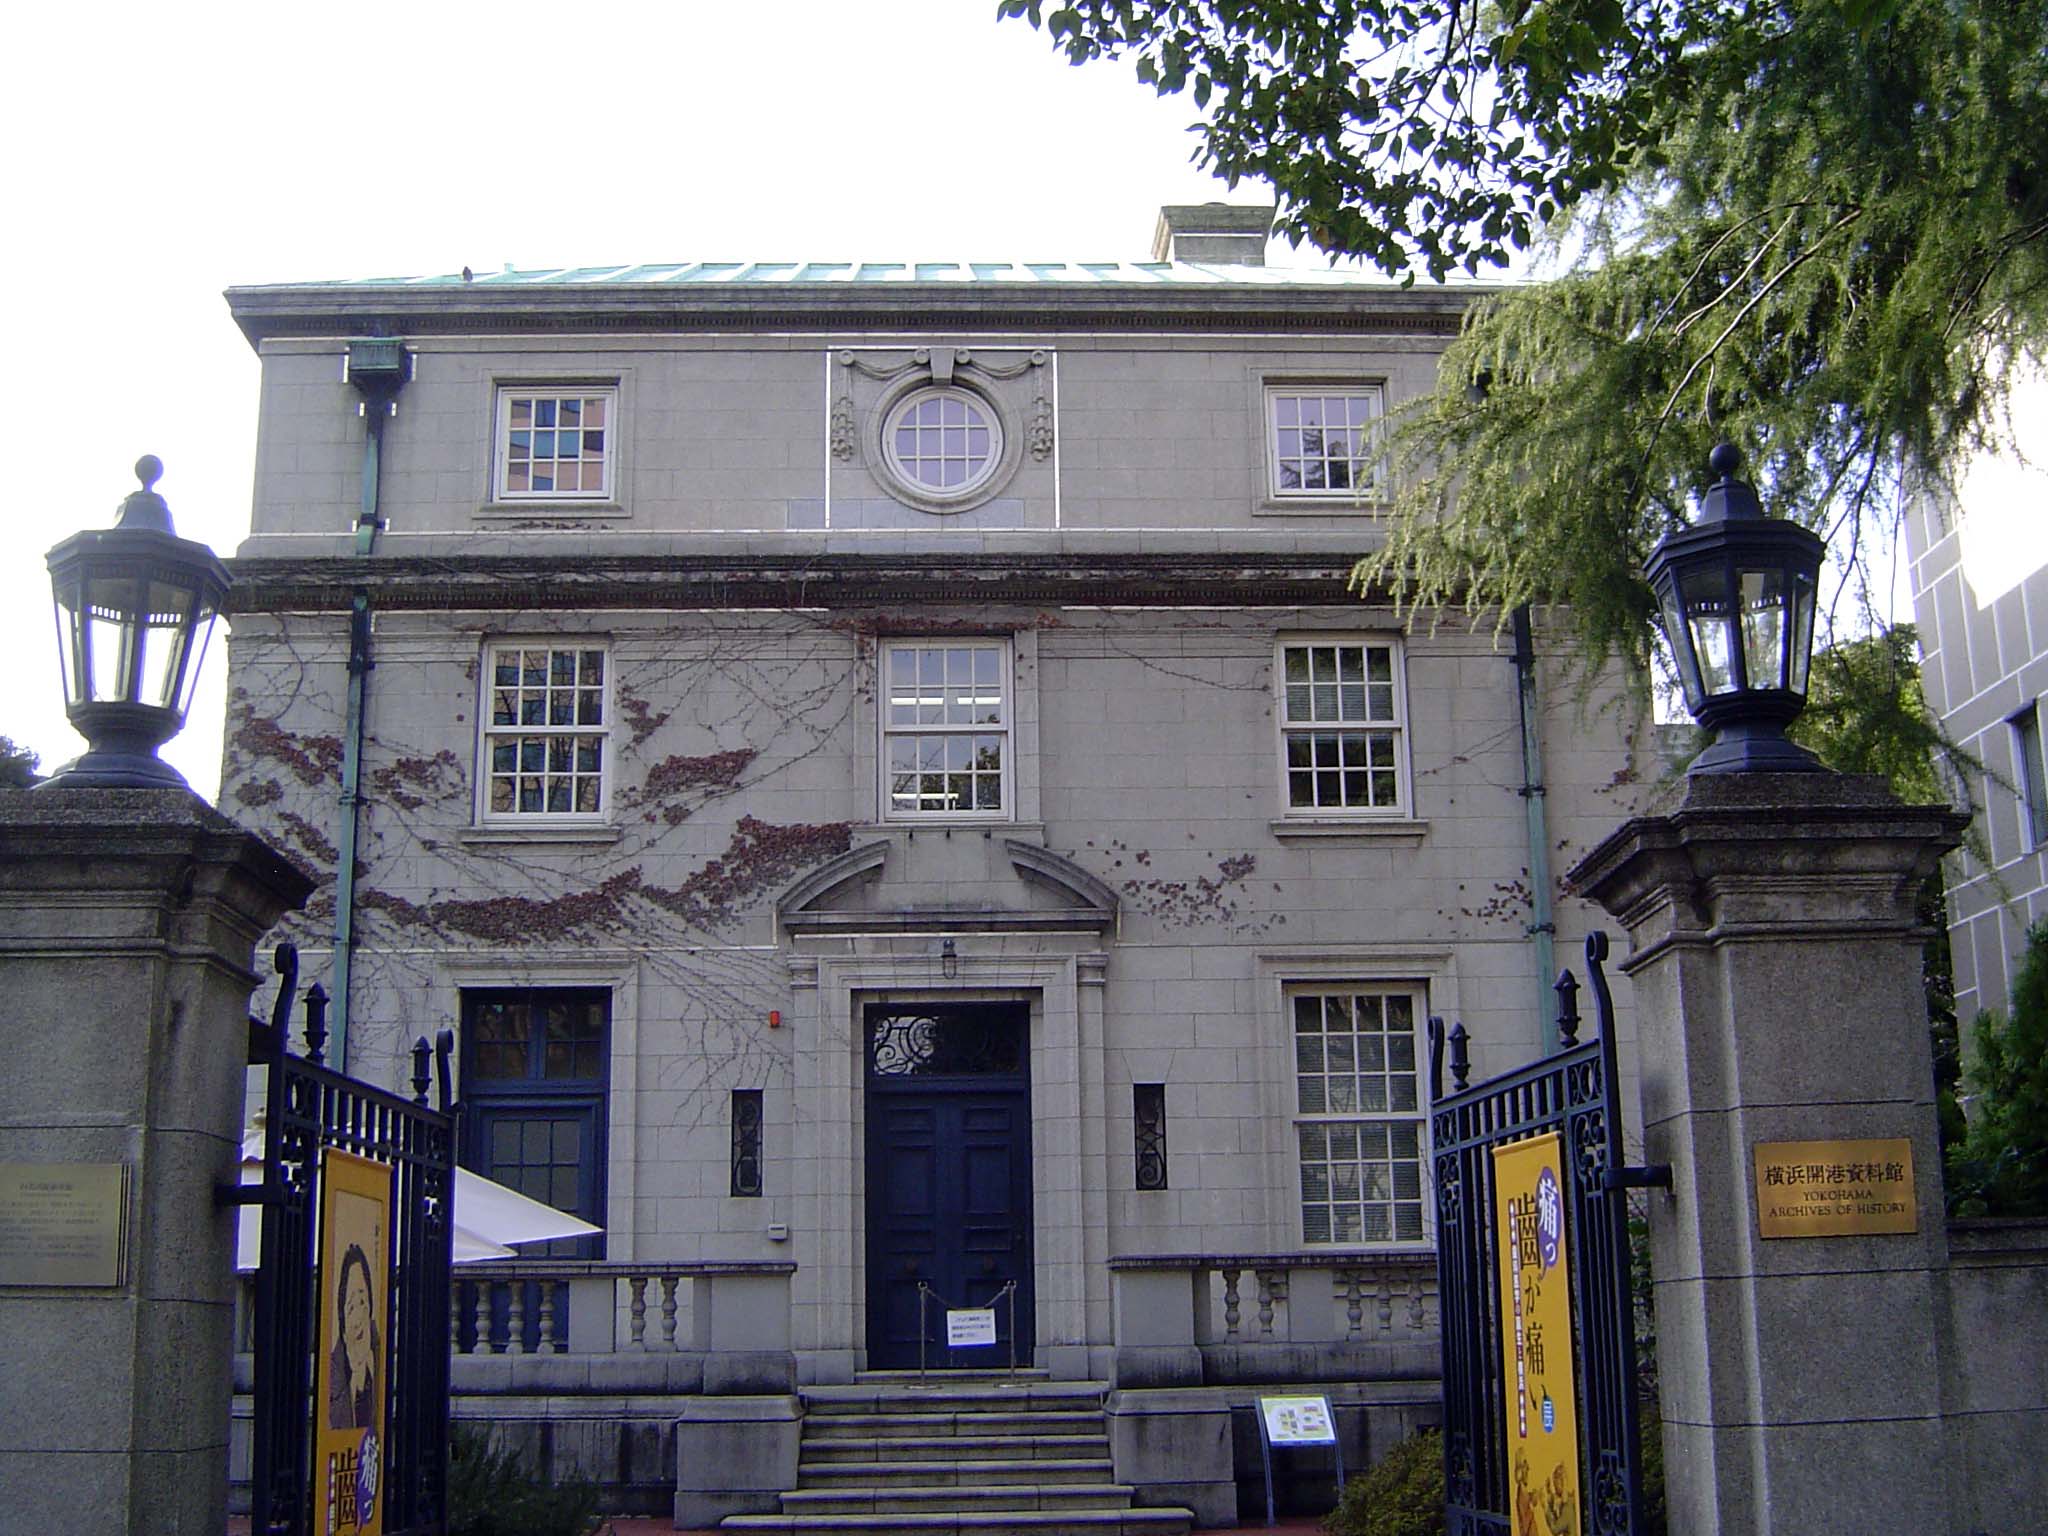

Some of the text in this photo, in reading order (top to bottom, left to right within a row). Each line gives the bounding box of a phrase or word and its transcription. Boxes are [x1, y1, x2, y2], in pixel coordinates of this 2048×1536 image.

[1764, 1162, 1904, 1187] 横浜開港資料館
[1803, 1189, 1874, 1201] YOKOHAMA
[1768, 1201, 1907, 1218] ARCHIVES OF HISTORY
